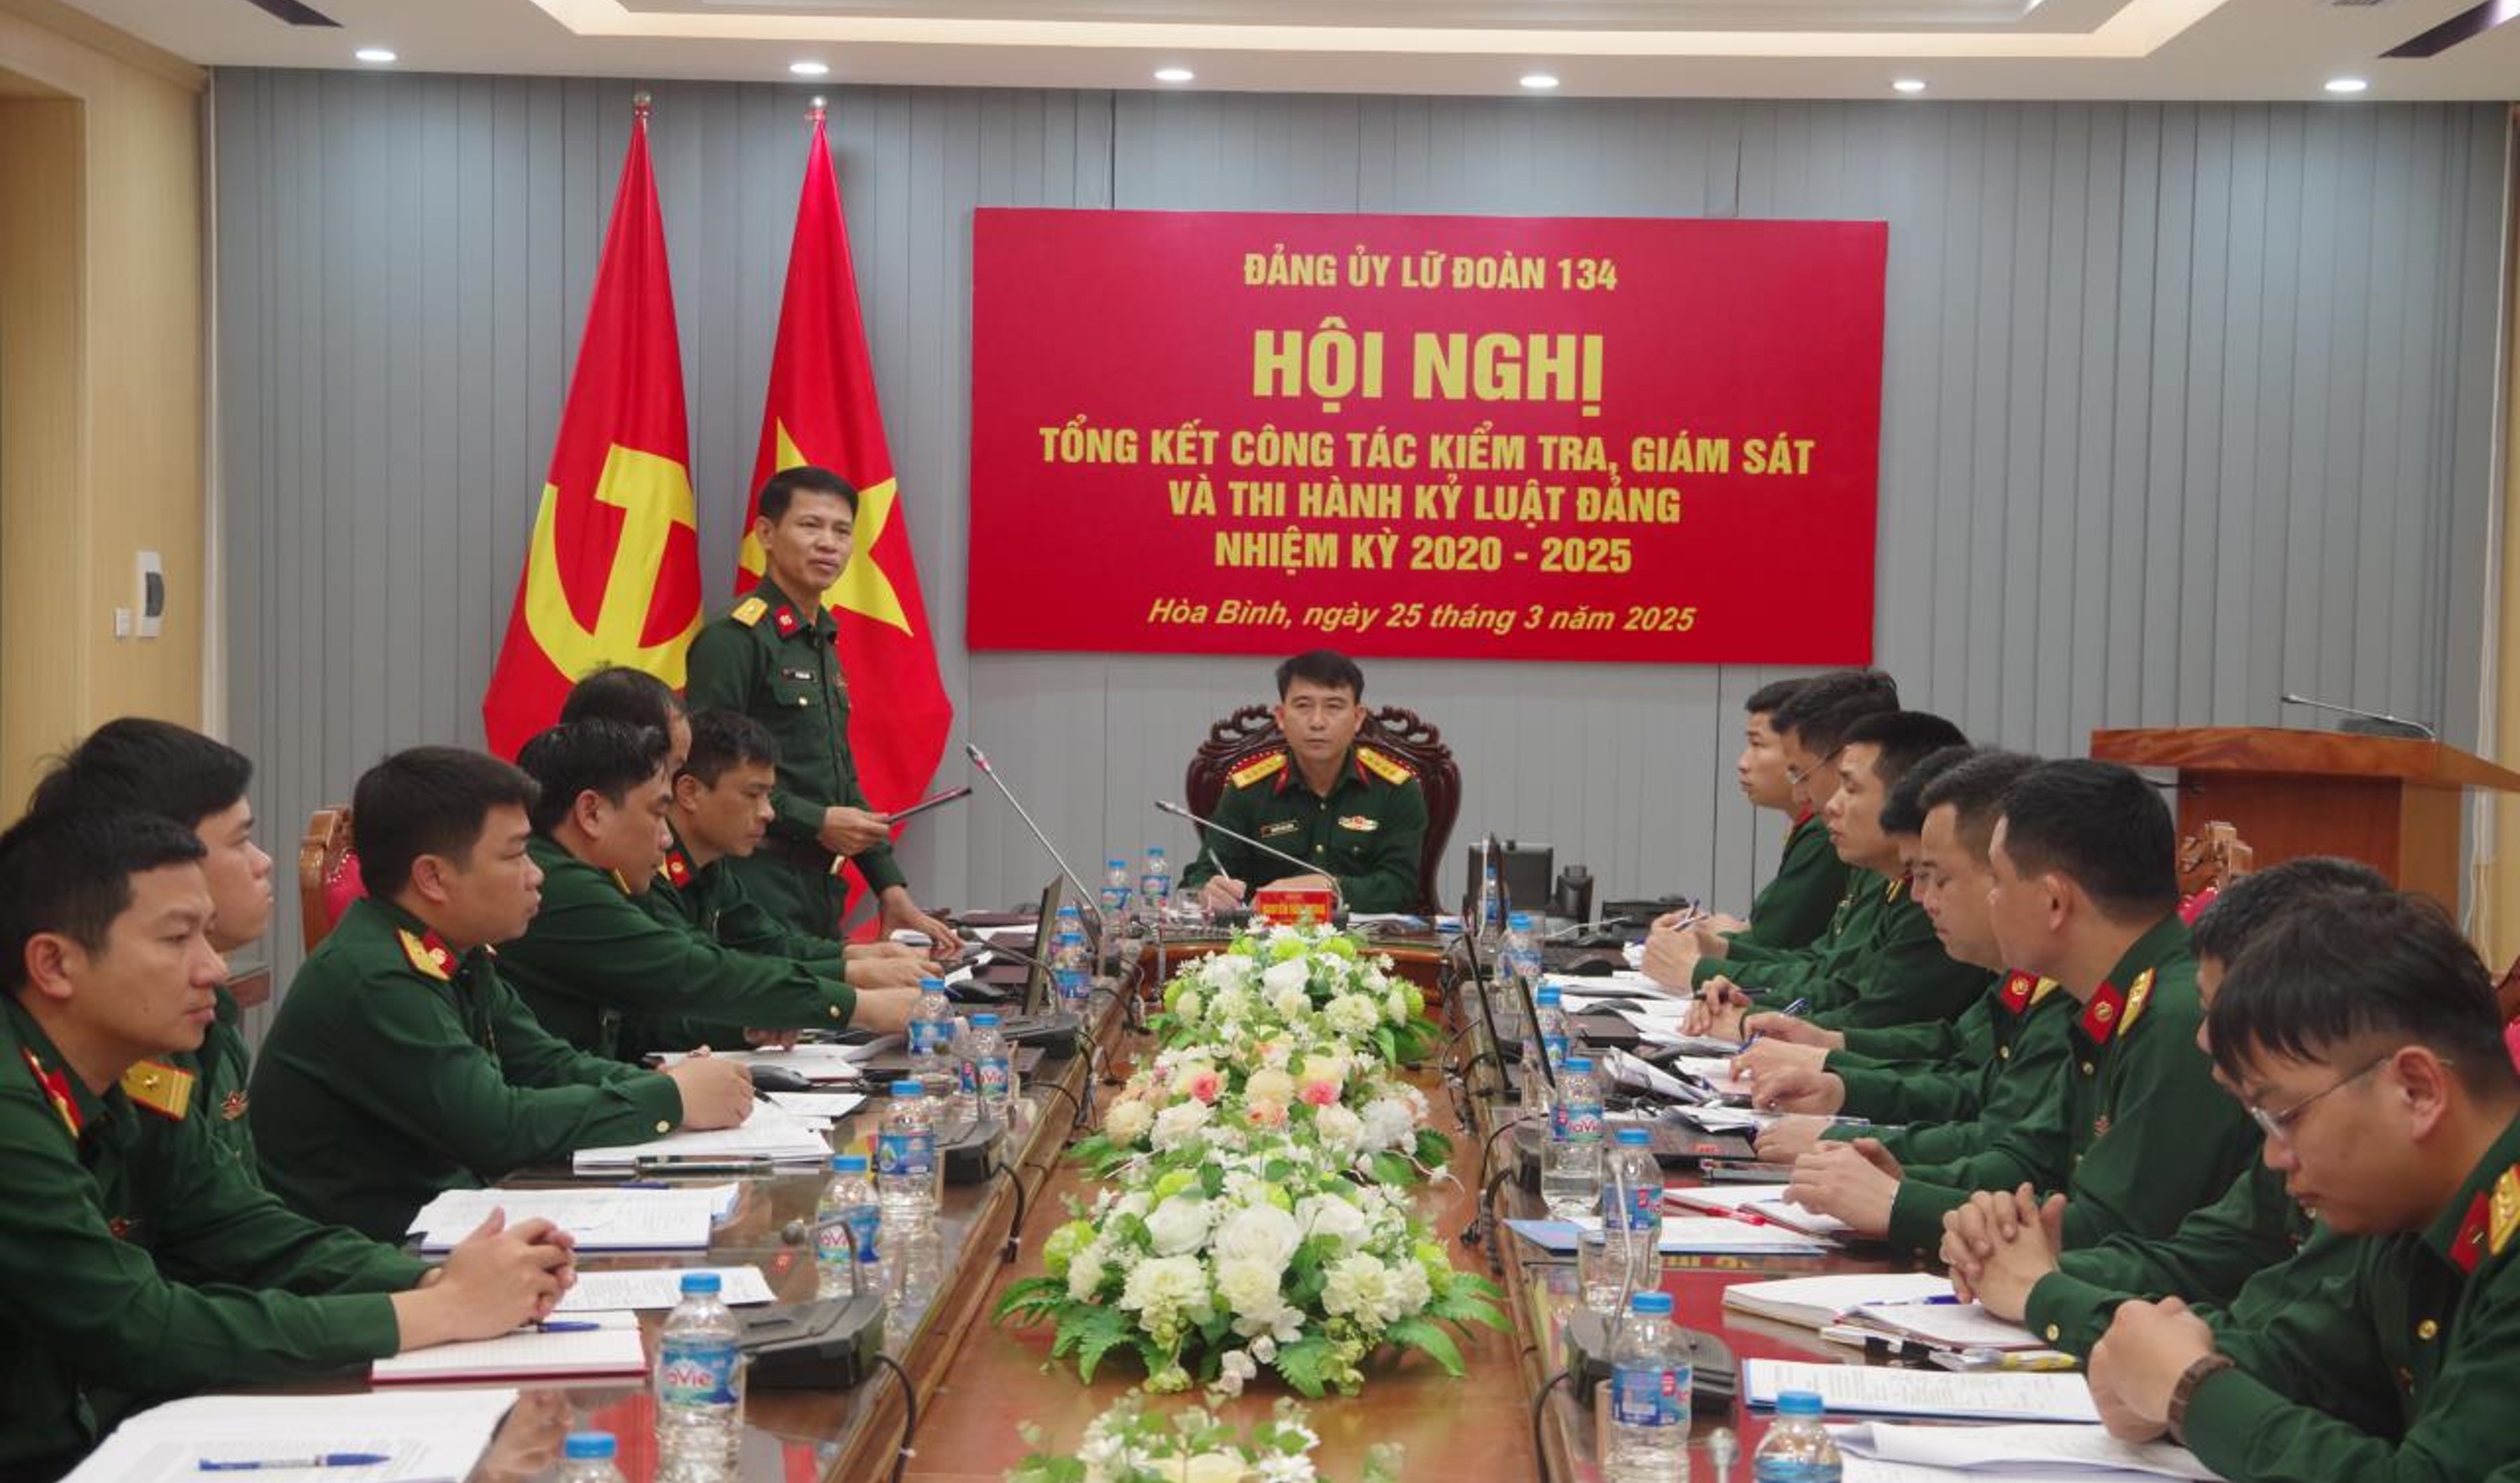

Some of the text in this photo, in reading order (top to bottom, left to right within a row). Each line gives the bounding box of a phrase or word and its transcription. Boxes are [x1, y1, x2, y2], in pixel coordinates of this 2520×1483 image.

[1244, 243, 1617, 290] ĐẢNG ỦY LỮ ĐOÀN 134
[1253, 316, 1603, 416] HỘI NGHỊ
[1039, 415, 1814, 477] TỔNG KẾT CÔNG TÁC KIỂM TRA, GIÁM SÁT
[1169, 474, 1680, 527] VÀ THI HÀNH KỶ LUẬT ĐẢNG
[1216, 525, 1631, 574] NHIỆM KỲ 2020 - 2025
[1149, 600, 1696, 634] Hòa Bình, ngày 25 tháng 3 năm 2025
[665, 1368, 712, 1386] aVie
